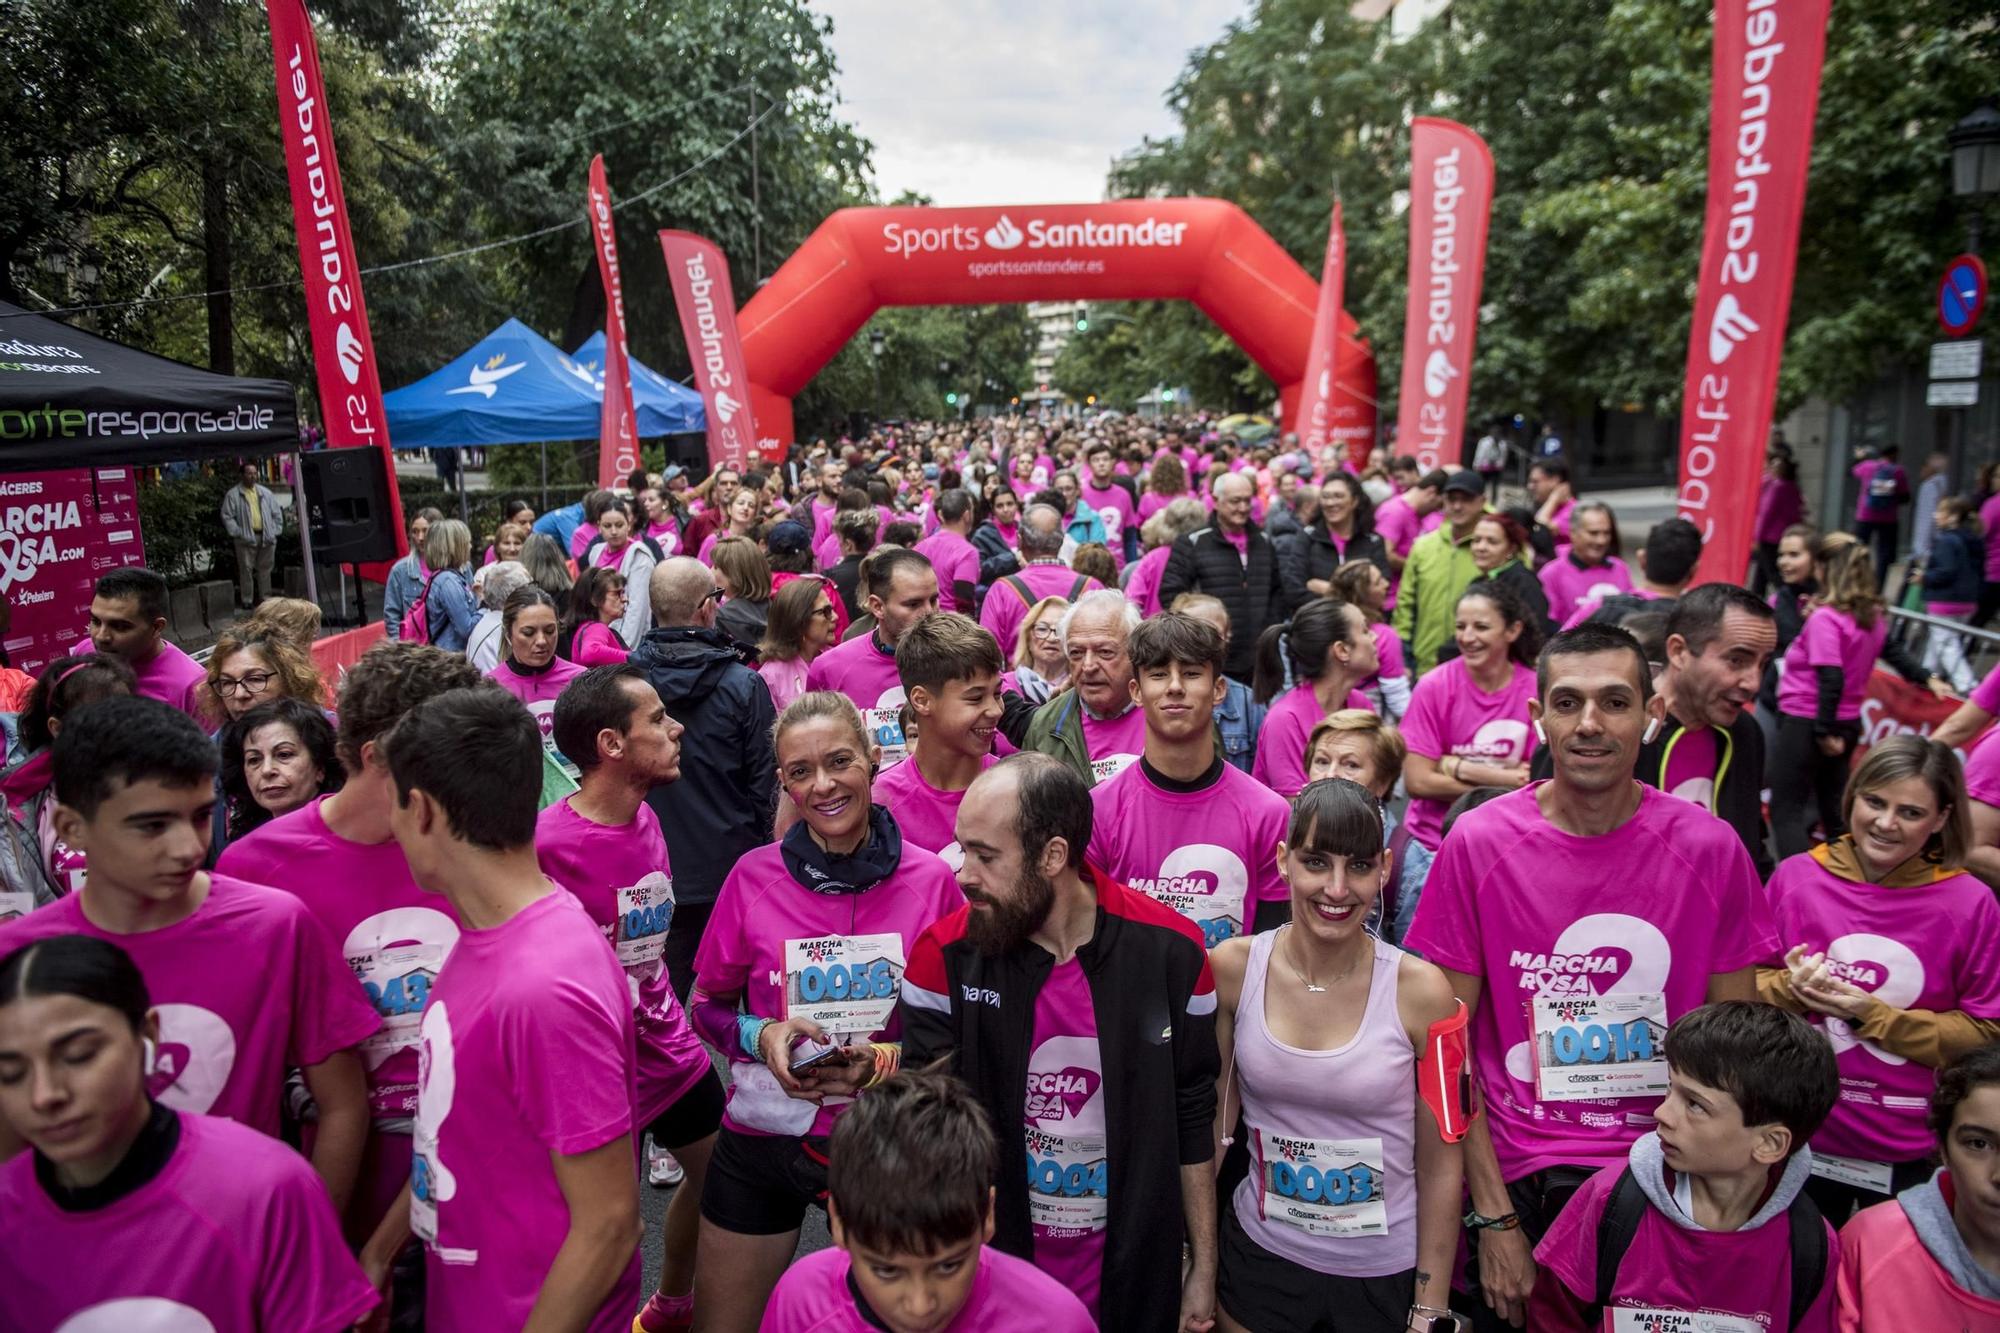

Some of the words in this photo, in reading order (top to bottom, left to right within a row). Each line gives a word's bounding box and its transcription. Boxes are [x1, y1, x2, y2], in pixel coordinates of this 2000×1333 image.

[883, 223, 980, 259] Sports
[1028, 218, 1188, 248] Santander
[968, 258, 1105, 277] sportssantander.es
[0, 501, 82, 535] RCHA
[1128, 878, 1208, 894] MARCHA
[1157, 895, 1194, 903] MARCHA
[799, 940, 842, 951] MARCHA
[1509, 950, 1617, 974] MARCHA
[800, 961, 893, 1002] 0056
[1824, 959, 1877, 985] RCHA
[1548, 1000, 1597, 1010] MARCHA
[1554, 1022, 1653, 1064] 0014
[1024, 1127, 1064, 1146] MARCHA
[1272, 1136, 1315, 1150] MARCHA
[1274, 1160, 1373, 1206] 0003
[1634, 1313, 1690, 1325] MARCHA
